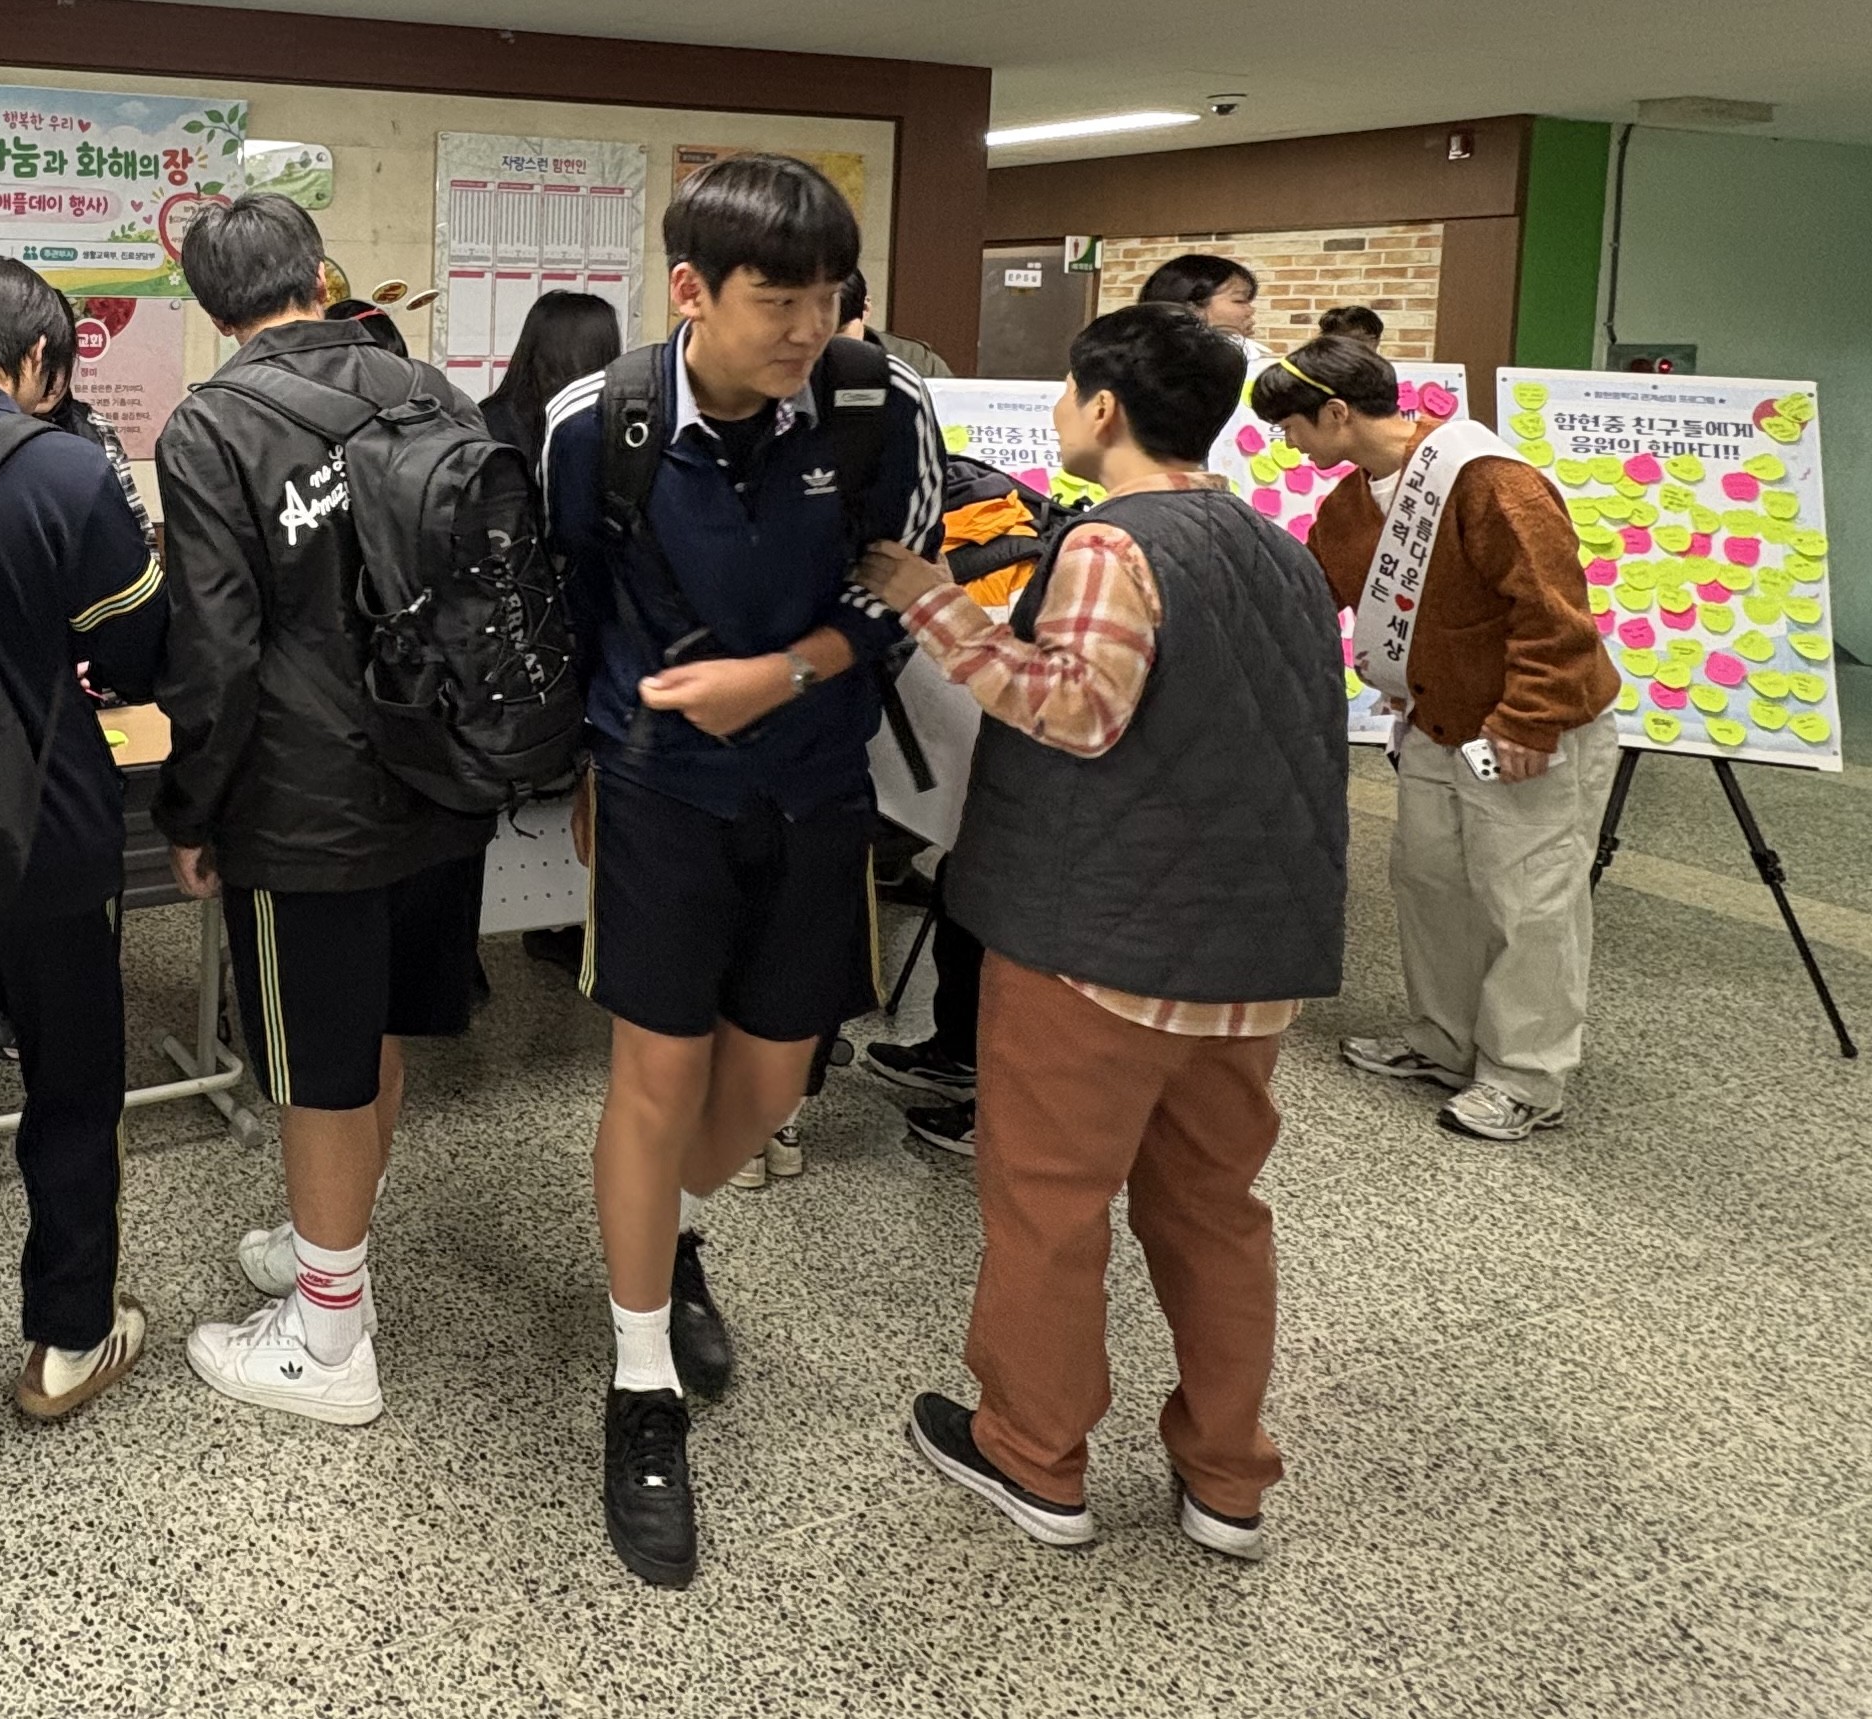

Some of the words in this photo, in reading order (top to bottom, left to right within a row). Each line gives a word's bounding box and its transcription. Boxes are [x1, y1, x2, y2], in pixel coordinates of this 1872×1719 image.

[3, 111, 43, 131] 행복한
[48, 114, 74, 132] 우리
[501, 155, 547, 173] 자랑스런
[68, 194, 109, 218] 행사)
[965, 425, 1023, 445] 함현중
[1554, 412, 1626, 435] 함현중
[1632, 416, 1754, 438] 친구들에게
[980, 447, 1037, 466] 응원의
[1569, 436, 1641, 455] 응원의
[1647, 439, 1741, 460] 한마디!!
[1391, 446, 1438, 547] 학교폭력
[1400, 490, 1440, 592] 아름다운
[1369, 553, 1400, 603] 없는
[1383, 614, 1409, 662] 세상
